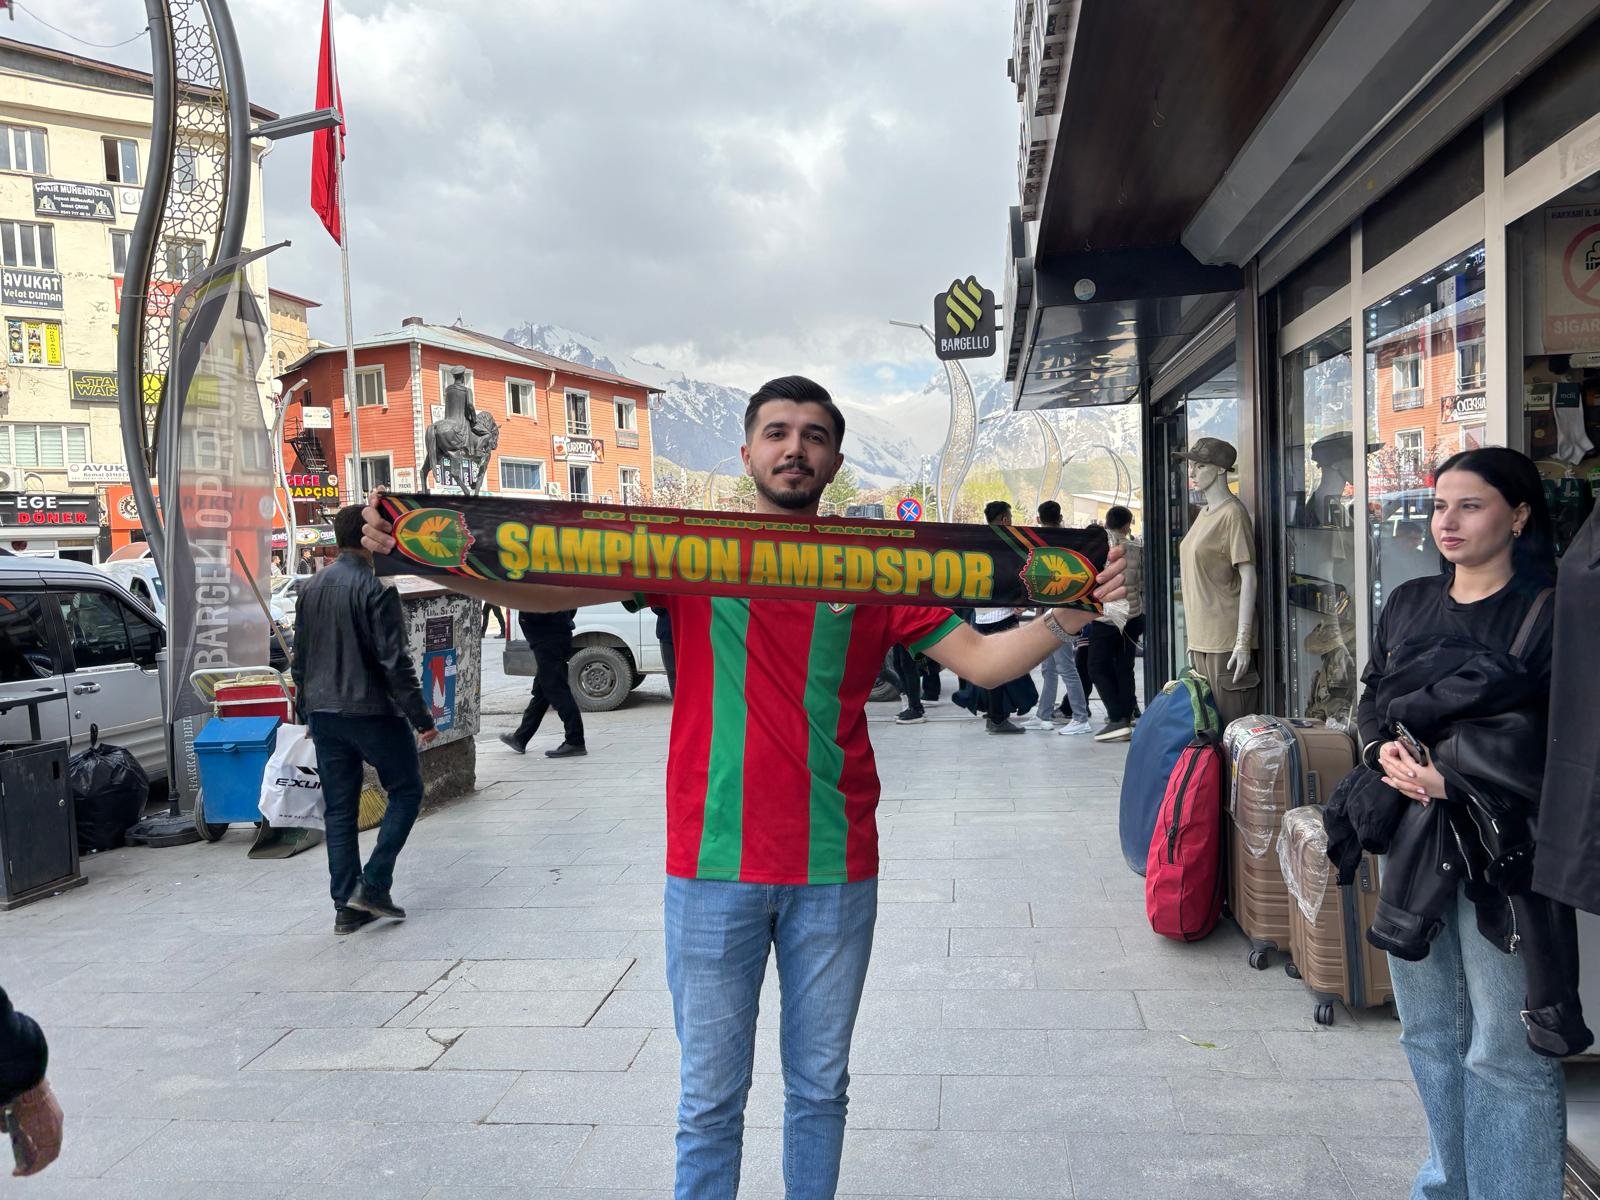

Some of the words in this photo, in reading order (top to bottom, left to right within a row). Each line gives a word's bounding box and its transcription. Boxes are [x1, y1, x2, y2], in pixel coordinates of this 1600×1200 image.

[3, 272, 60, 291] AVUKAT
[3, 288, 28, 299] Velat
[941, 335, 990, 352] BARGELLO
[75, 375, 119, 387] STA
[83, 464, 129, 472] AVUK
[16, 496, 57, 509] EGE
[17, 510, 88, 524] DÖNER
[496, 521, 741, 583] ŞAMPİYON
[749, 540, 995, 601] AMEDSPOR
[194, 508, 233, 670] BARGELLO
[181, 741, 199, 792] HAKKARİ
